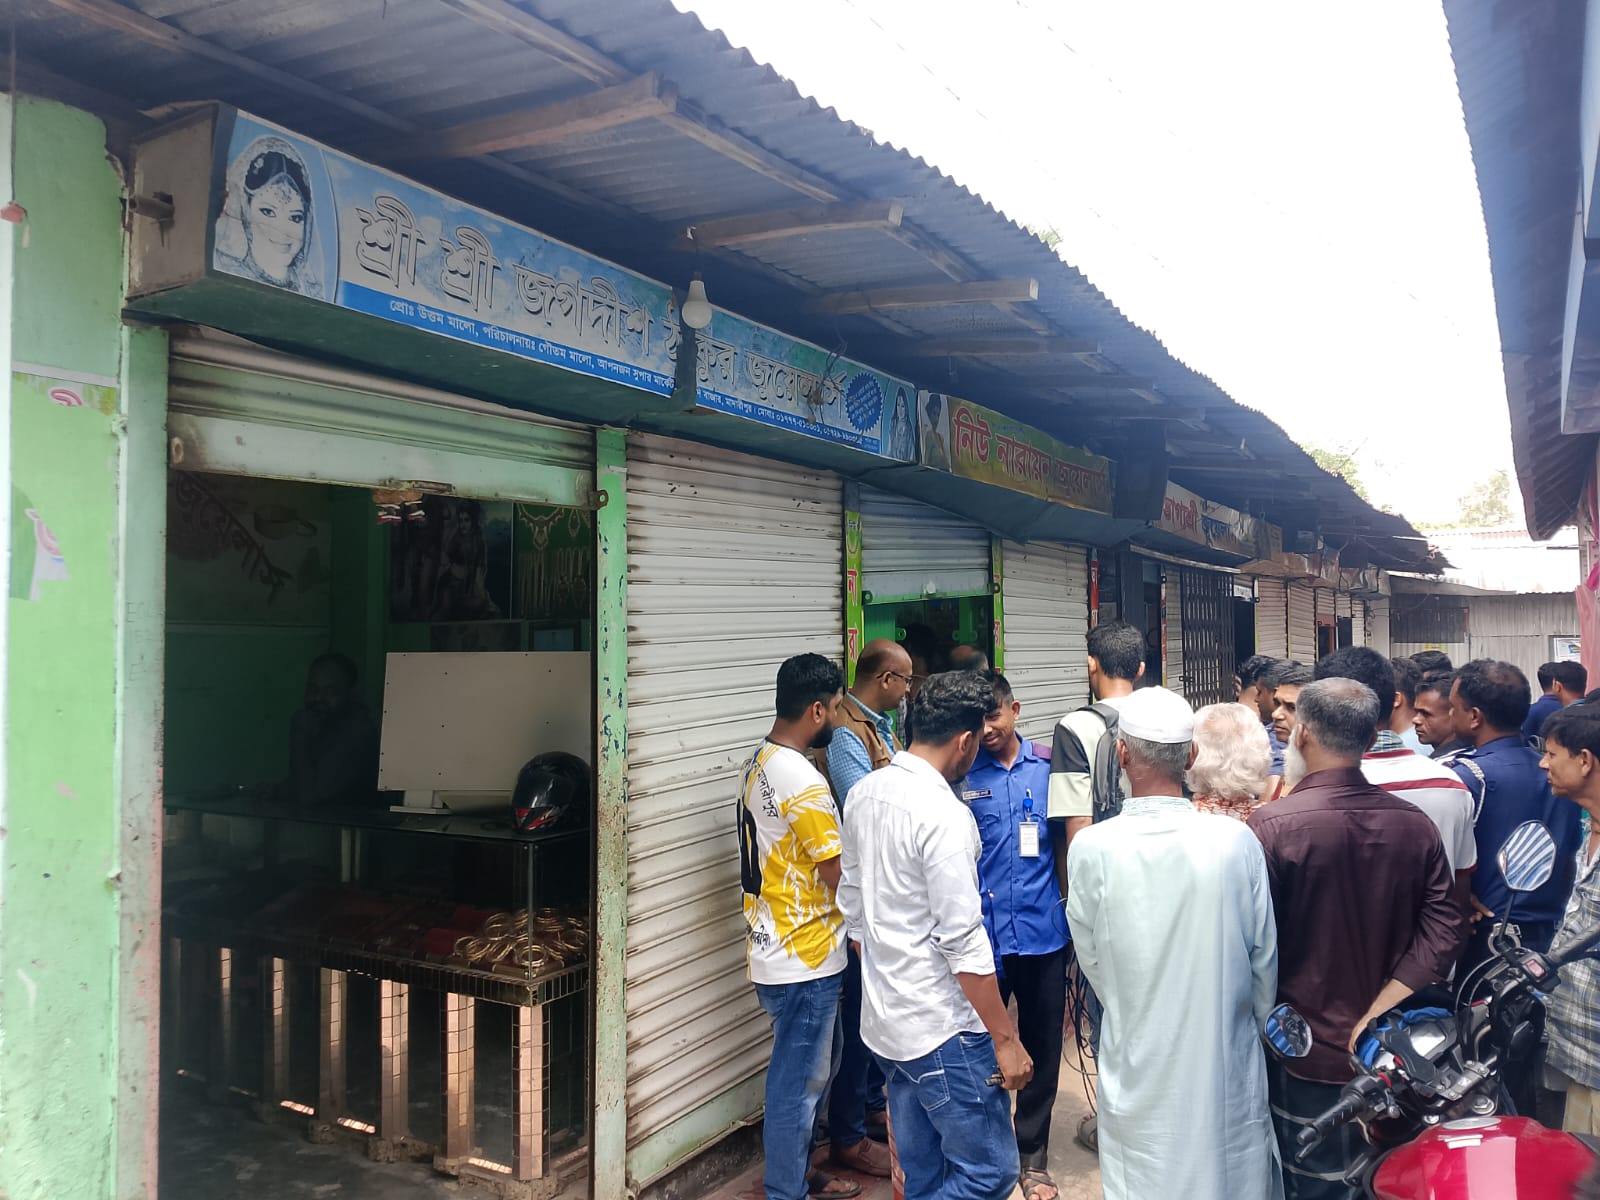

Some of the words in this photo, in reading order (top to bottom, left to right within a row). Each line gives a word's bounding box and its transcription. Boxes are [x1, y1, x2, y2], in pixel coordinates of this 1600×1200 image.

[356, 196, 425, 288] শ্রী
[440, 226, 501, 312] শ্রী
[953, 406, 992, 465] নিউ
